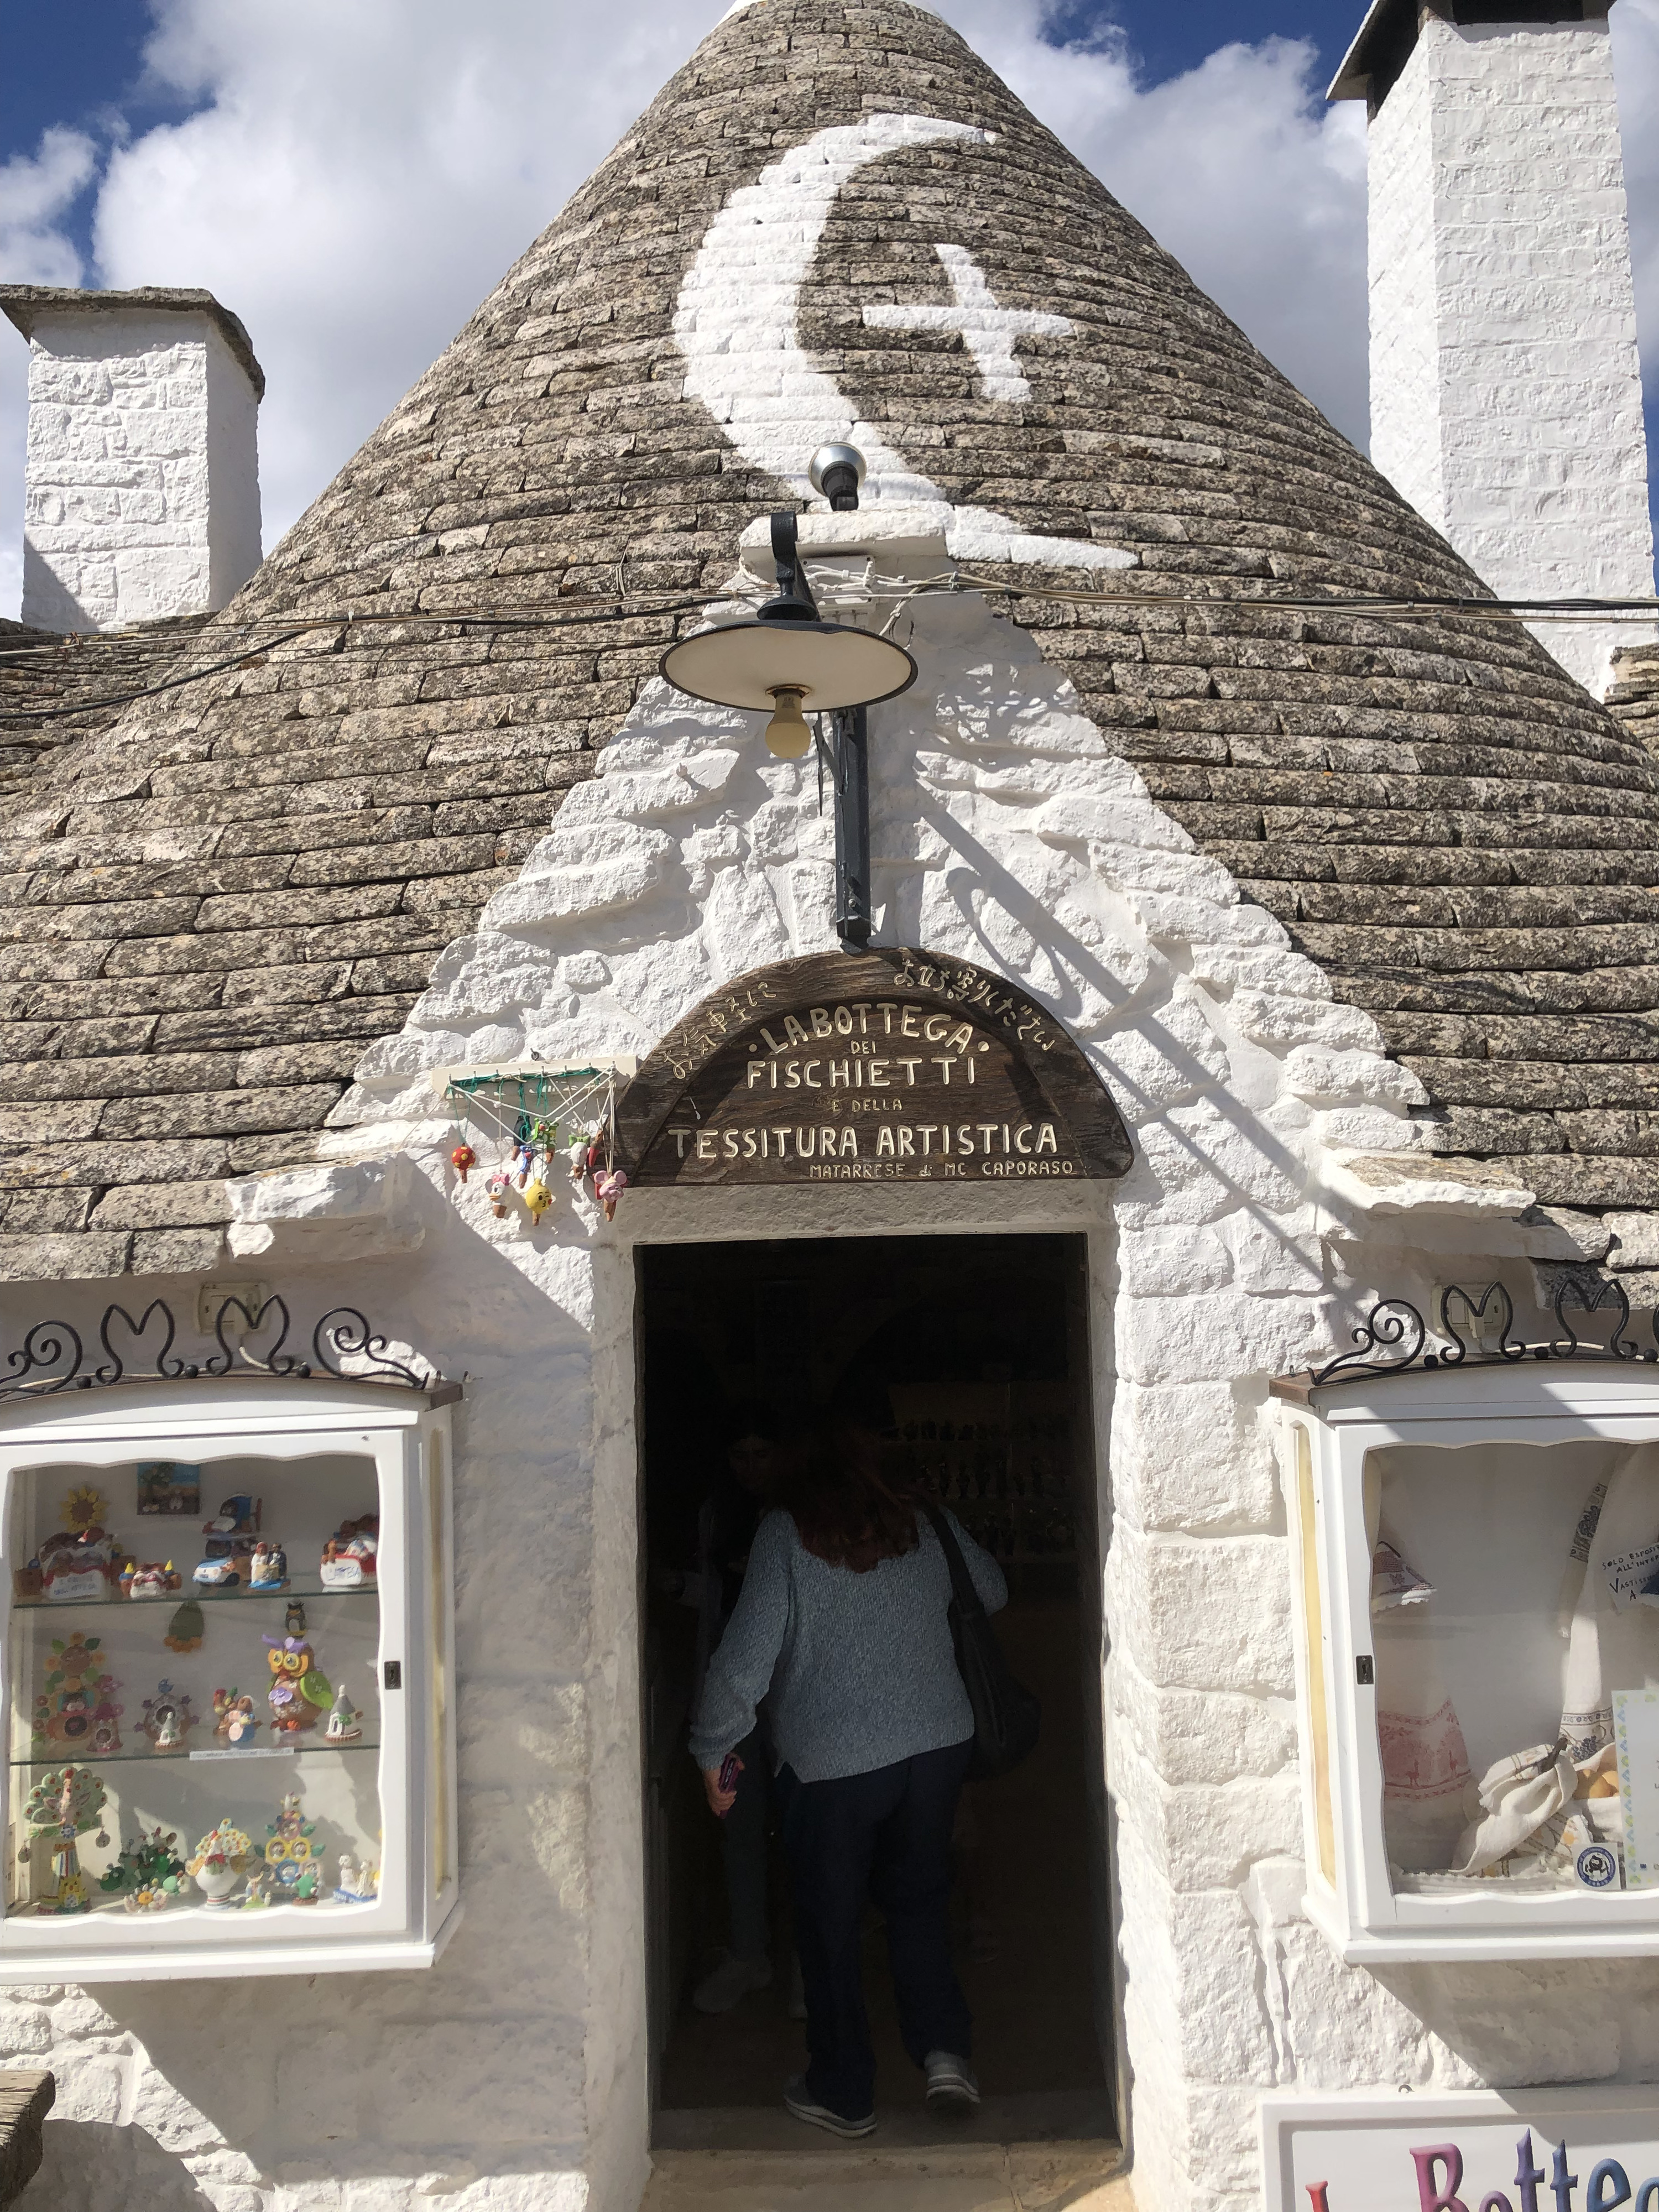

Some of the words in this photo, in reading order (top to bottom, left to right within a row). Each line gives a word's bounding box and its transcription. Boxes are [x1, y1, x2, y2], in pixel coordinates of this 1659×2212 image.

[664, 982, 776, 1079] お気軽に
[850, 1040, 877, 1055] DEI
[747, 1056, 975, 1088] FISCHIETTI
[831, 1099, 841, 1112] E
[851, 1098, 903, 1113] DELLA
[667, 1126, 858, 1159] TESSITURA
[875, 1123, 1057, 1156] ARTISTICA
[810, 1162, 906, 1178] MATARRESE
[918, 1164, 933, 1177] di
[945, 1162, 967, 1176] MC
[982, 1160, 1073, 1176] CAPORASO
[1602, 1557, 1624, 1571] SOLO
